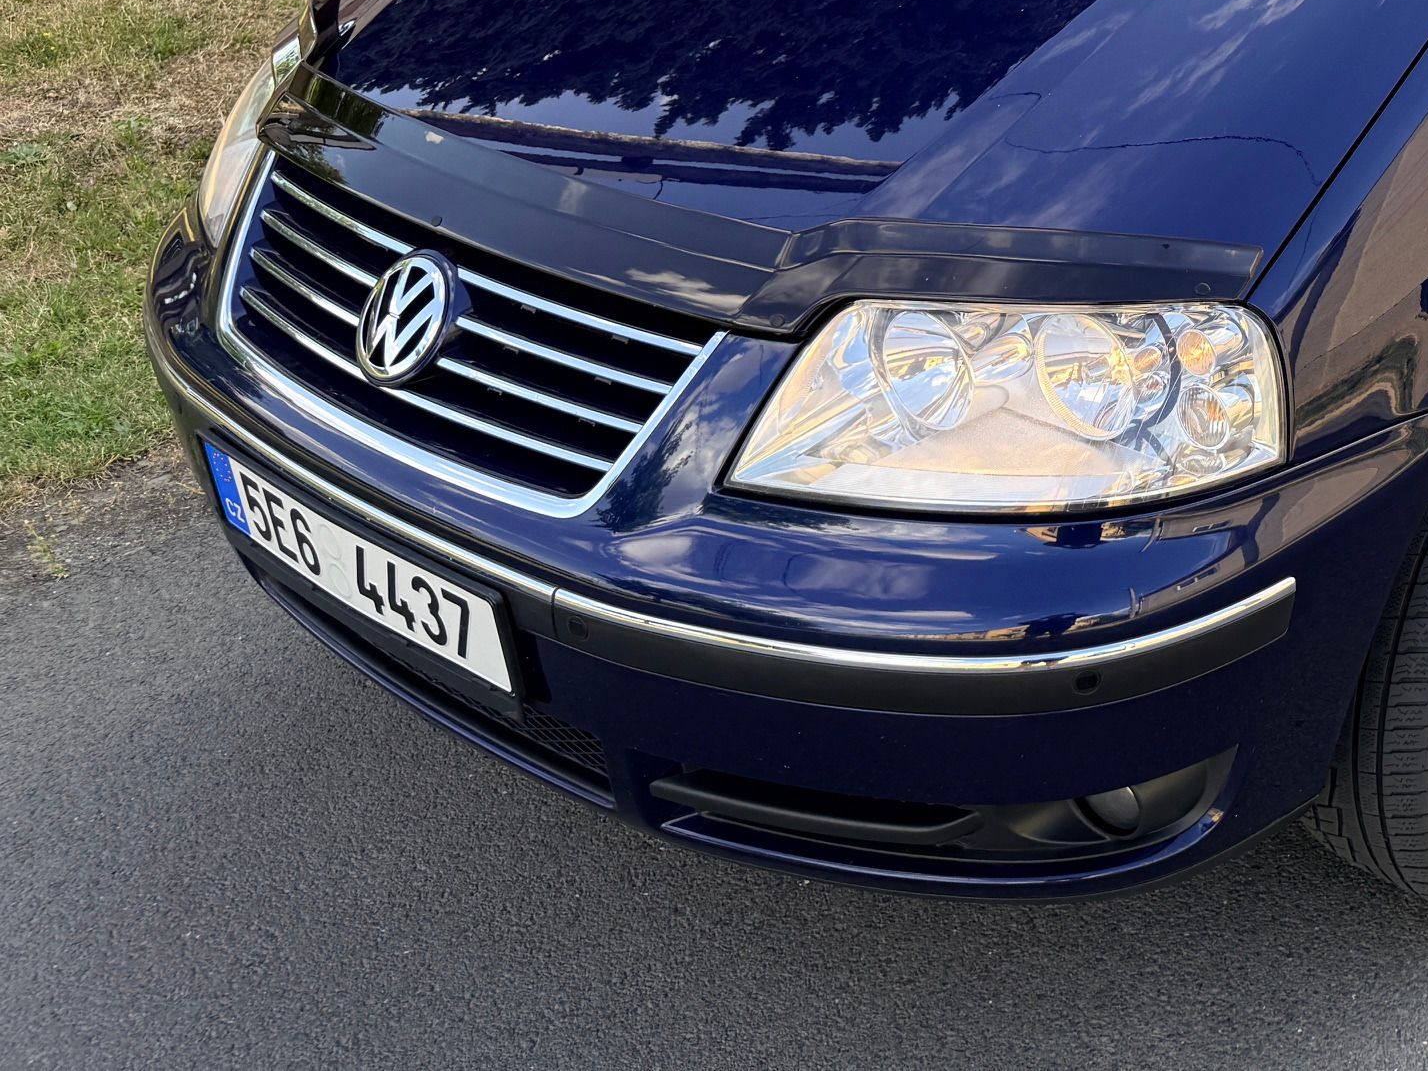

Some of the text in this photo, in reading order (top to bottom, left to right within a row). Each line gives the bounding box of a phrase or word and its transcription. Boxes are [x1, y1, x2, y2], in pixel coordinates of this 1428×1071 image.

[358, 257, 445, 378] VW
[225, 497, 246, 523] CZ
[239, 470, 470, 659] 5E6 4437
